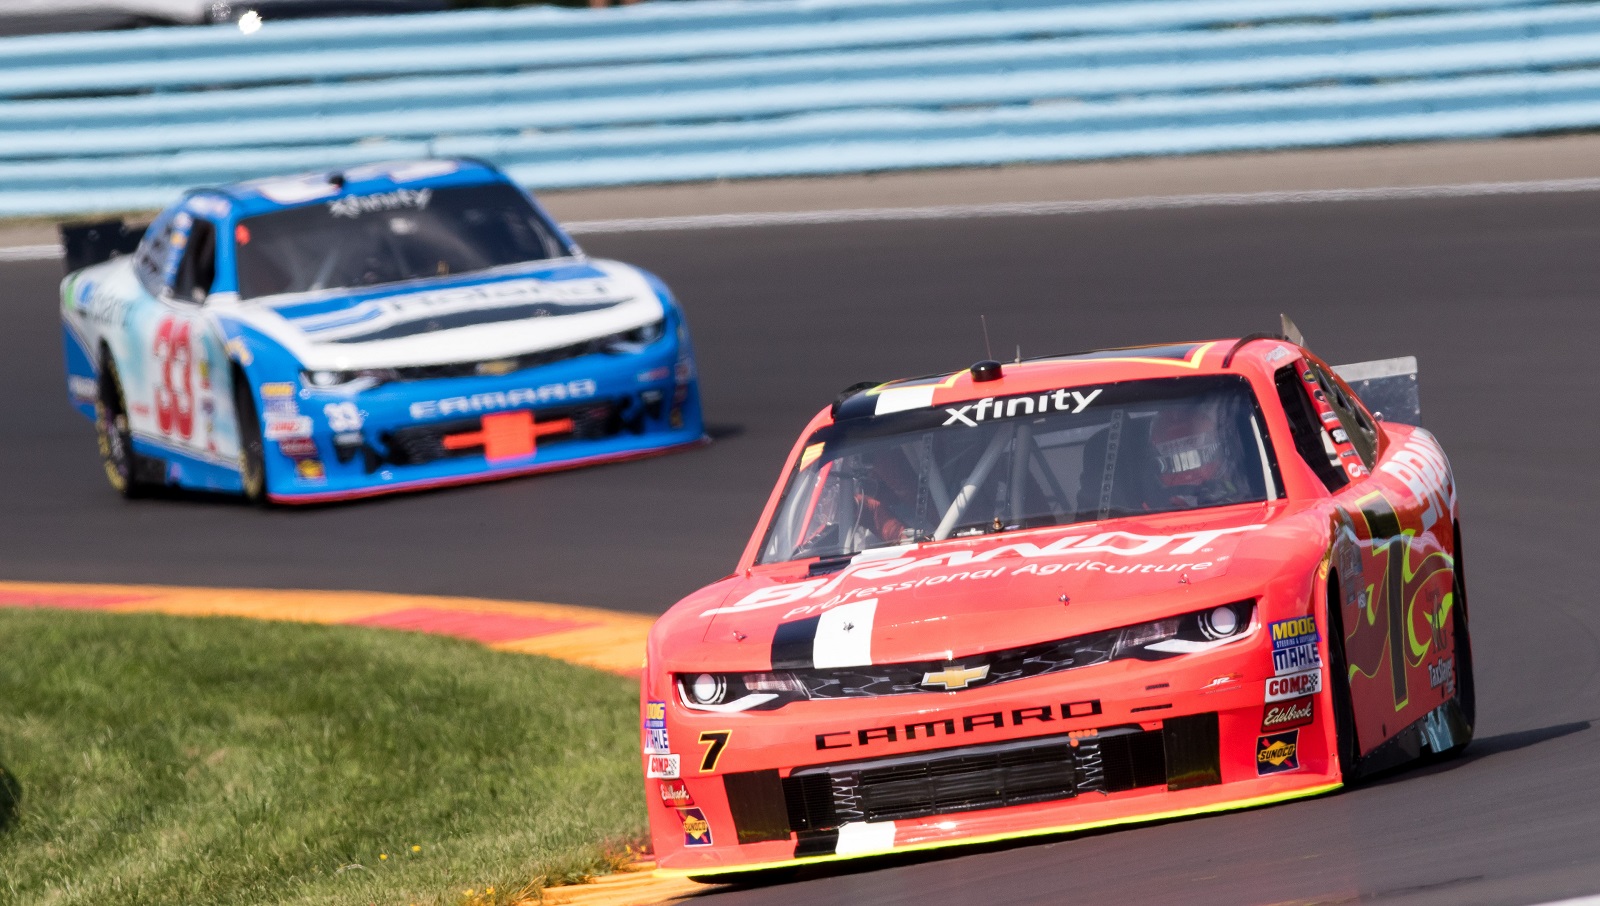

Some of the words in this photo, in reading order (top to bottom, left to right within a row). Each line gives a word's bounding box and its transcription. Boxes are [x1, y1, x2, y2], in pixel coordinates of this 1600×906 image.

[328, 188, 433, 218] xfinity
[153, 314, 195, 440] 33
[409, 378, 596, 420] CAMARO
[942, 388, 1103, 427] xfinity
[698, 525, 1264, 618] BRANDT
[1011, 560, 1213, 576] Agriculture
[1272, 616, 1315, 641] MOOG
[1273, 643, 1320, 672] MAHLE
[1268, 674, 1310, 697] COMP
[815, 699, 1103, 751] CAMARO
[1263, 702, 1313, 727] Edelbrock
[697, 729, 733, 773] 7
[1259, 744, 1297, 762] SUNOCO
[683, 820, 708, 833] SUNOCO
